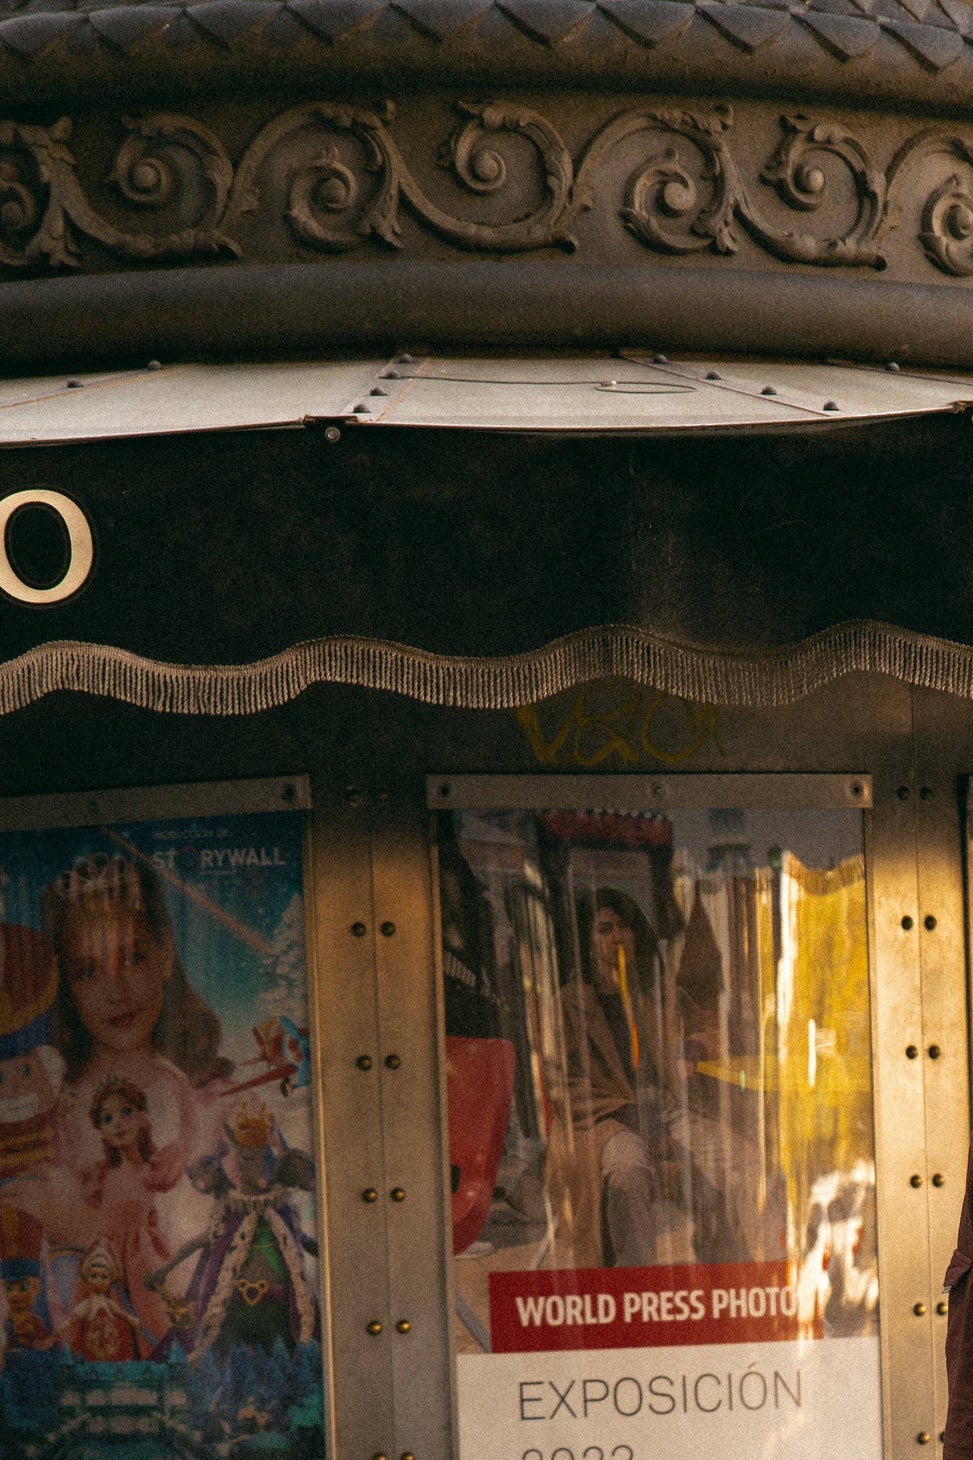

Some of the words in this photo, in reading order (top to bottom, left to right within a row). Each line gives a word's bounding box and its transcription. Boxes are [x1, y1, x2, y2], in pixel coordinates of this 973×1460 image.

[516, 1293, 616, 1327] WORLD
[624, 1289, 703, 1323] PRESS
[712, 1286, 798, 1319] PHOTO
[519, 1362, 802, 1421] EXPOSICIÓN
